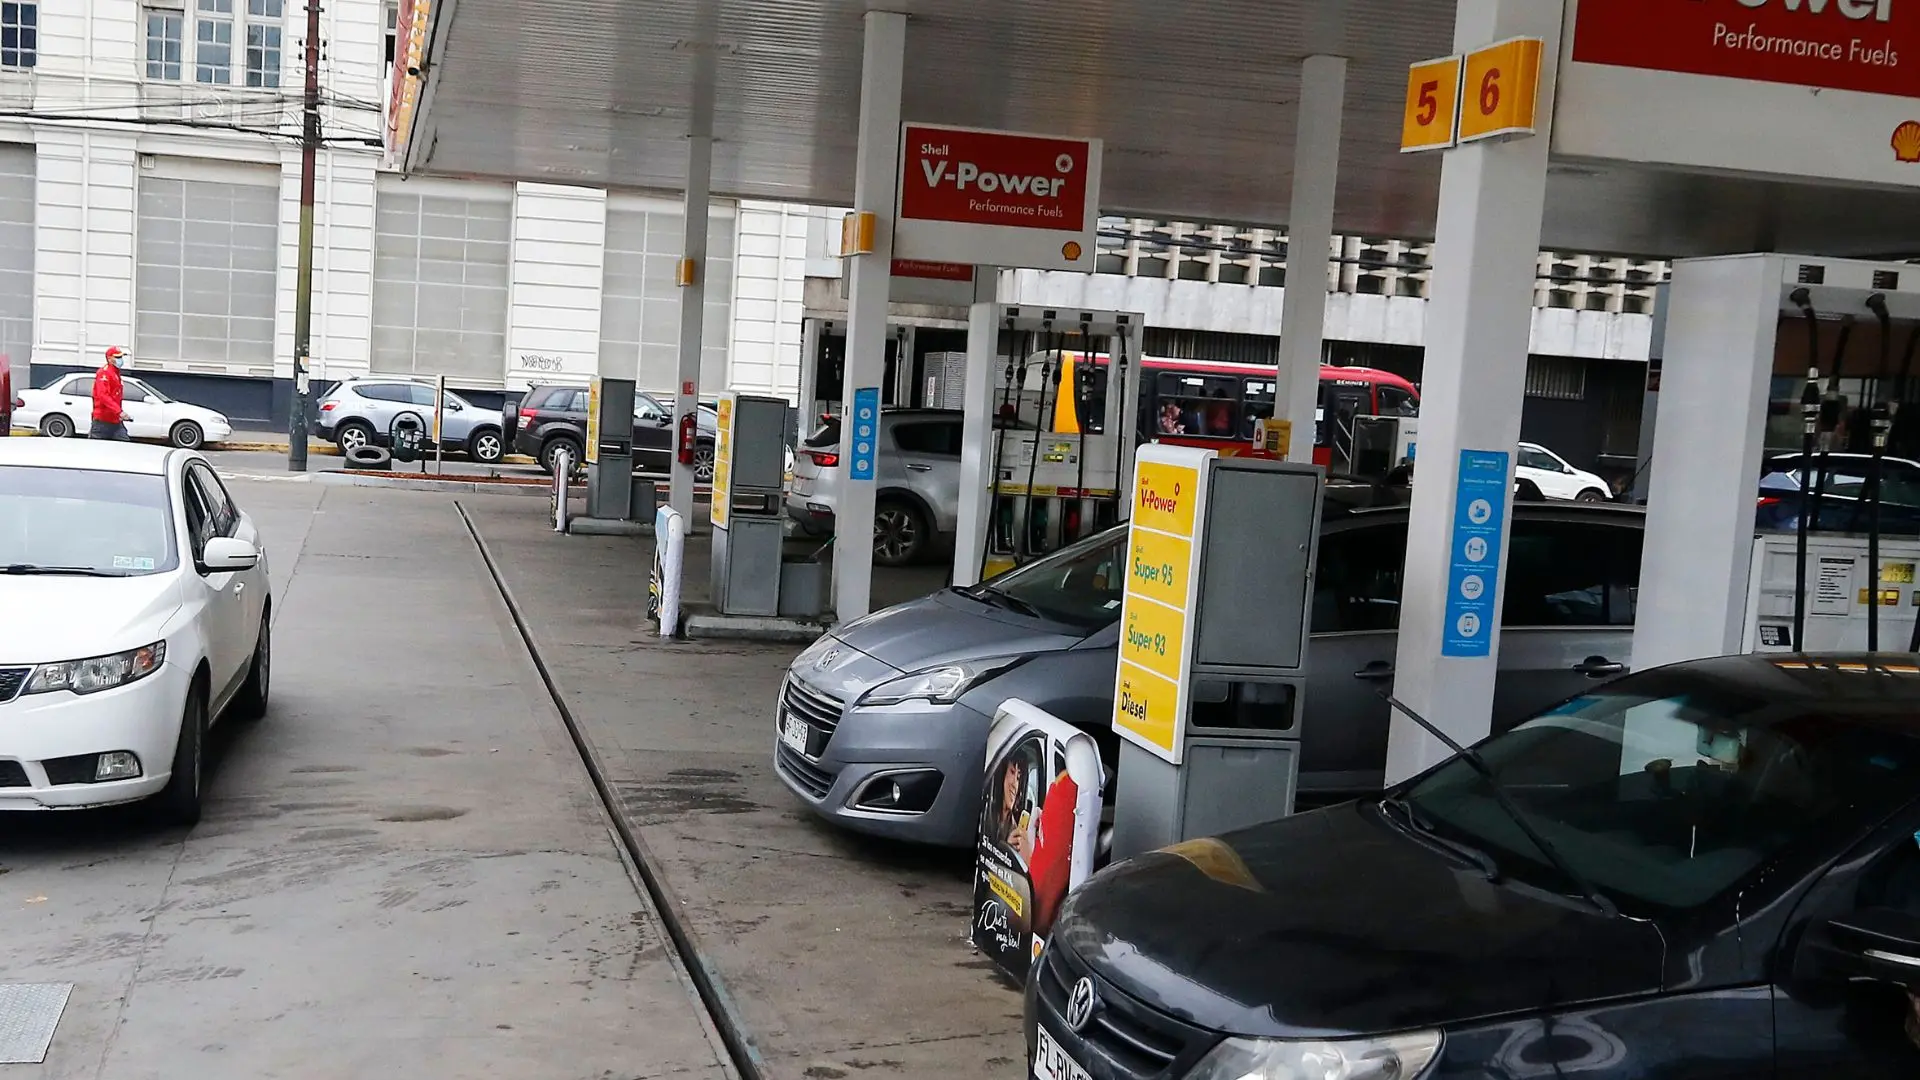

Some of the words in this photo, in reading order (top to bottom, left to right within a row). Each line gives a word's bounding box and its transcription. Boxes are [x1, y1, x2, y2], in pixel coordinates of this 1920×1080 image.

[1713, 22, 1842, 60] Performance
[1849, 38, 1899, 67] Fuels
[1416, 80, 1438, 126] 5
[1480, 67, 1501, 116] 6
[921, 143, 949, 155] Shell
[920, 158, 1065, 198] V-Power
[969, 199, 1035, 216] Performance
[1038, 205, 1064, 218] Fuels
[1141, 488, 1177, 514] V-Power
[1134, 556, 1160, 584] Super
[1162, 563, 1173, 586] 95
[1127, 624, 1152, 652] Super
[1155, 632, 1166, 656] 93
[1121, 691, 1148, 721] Diesel
